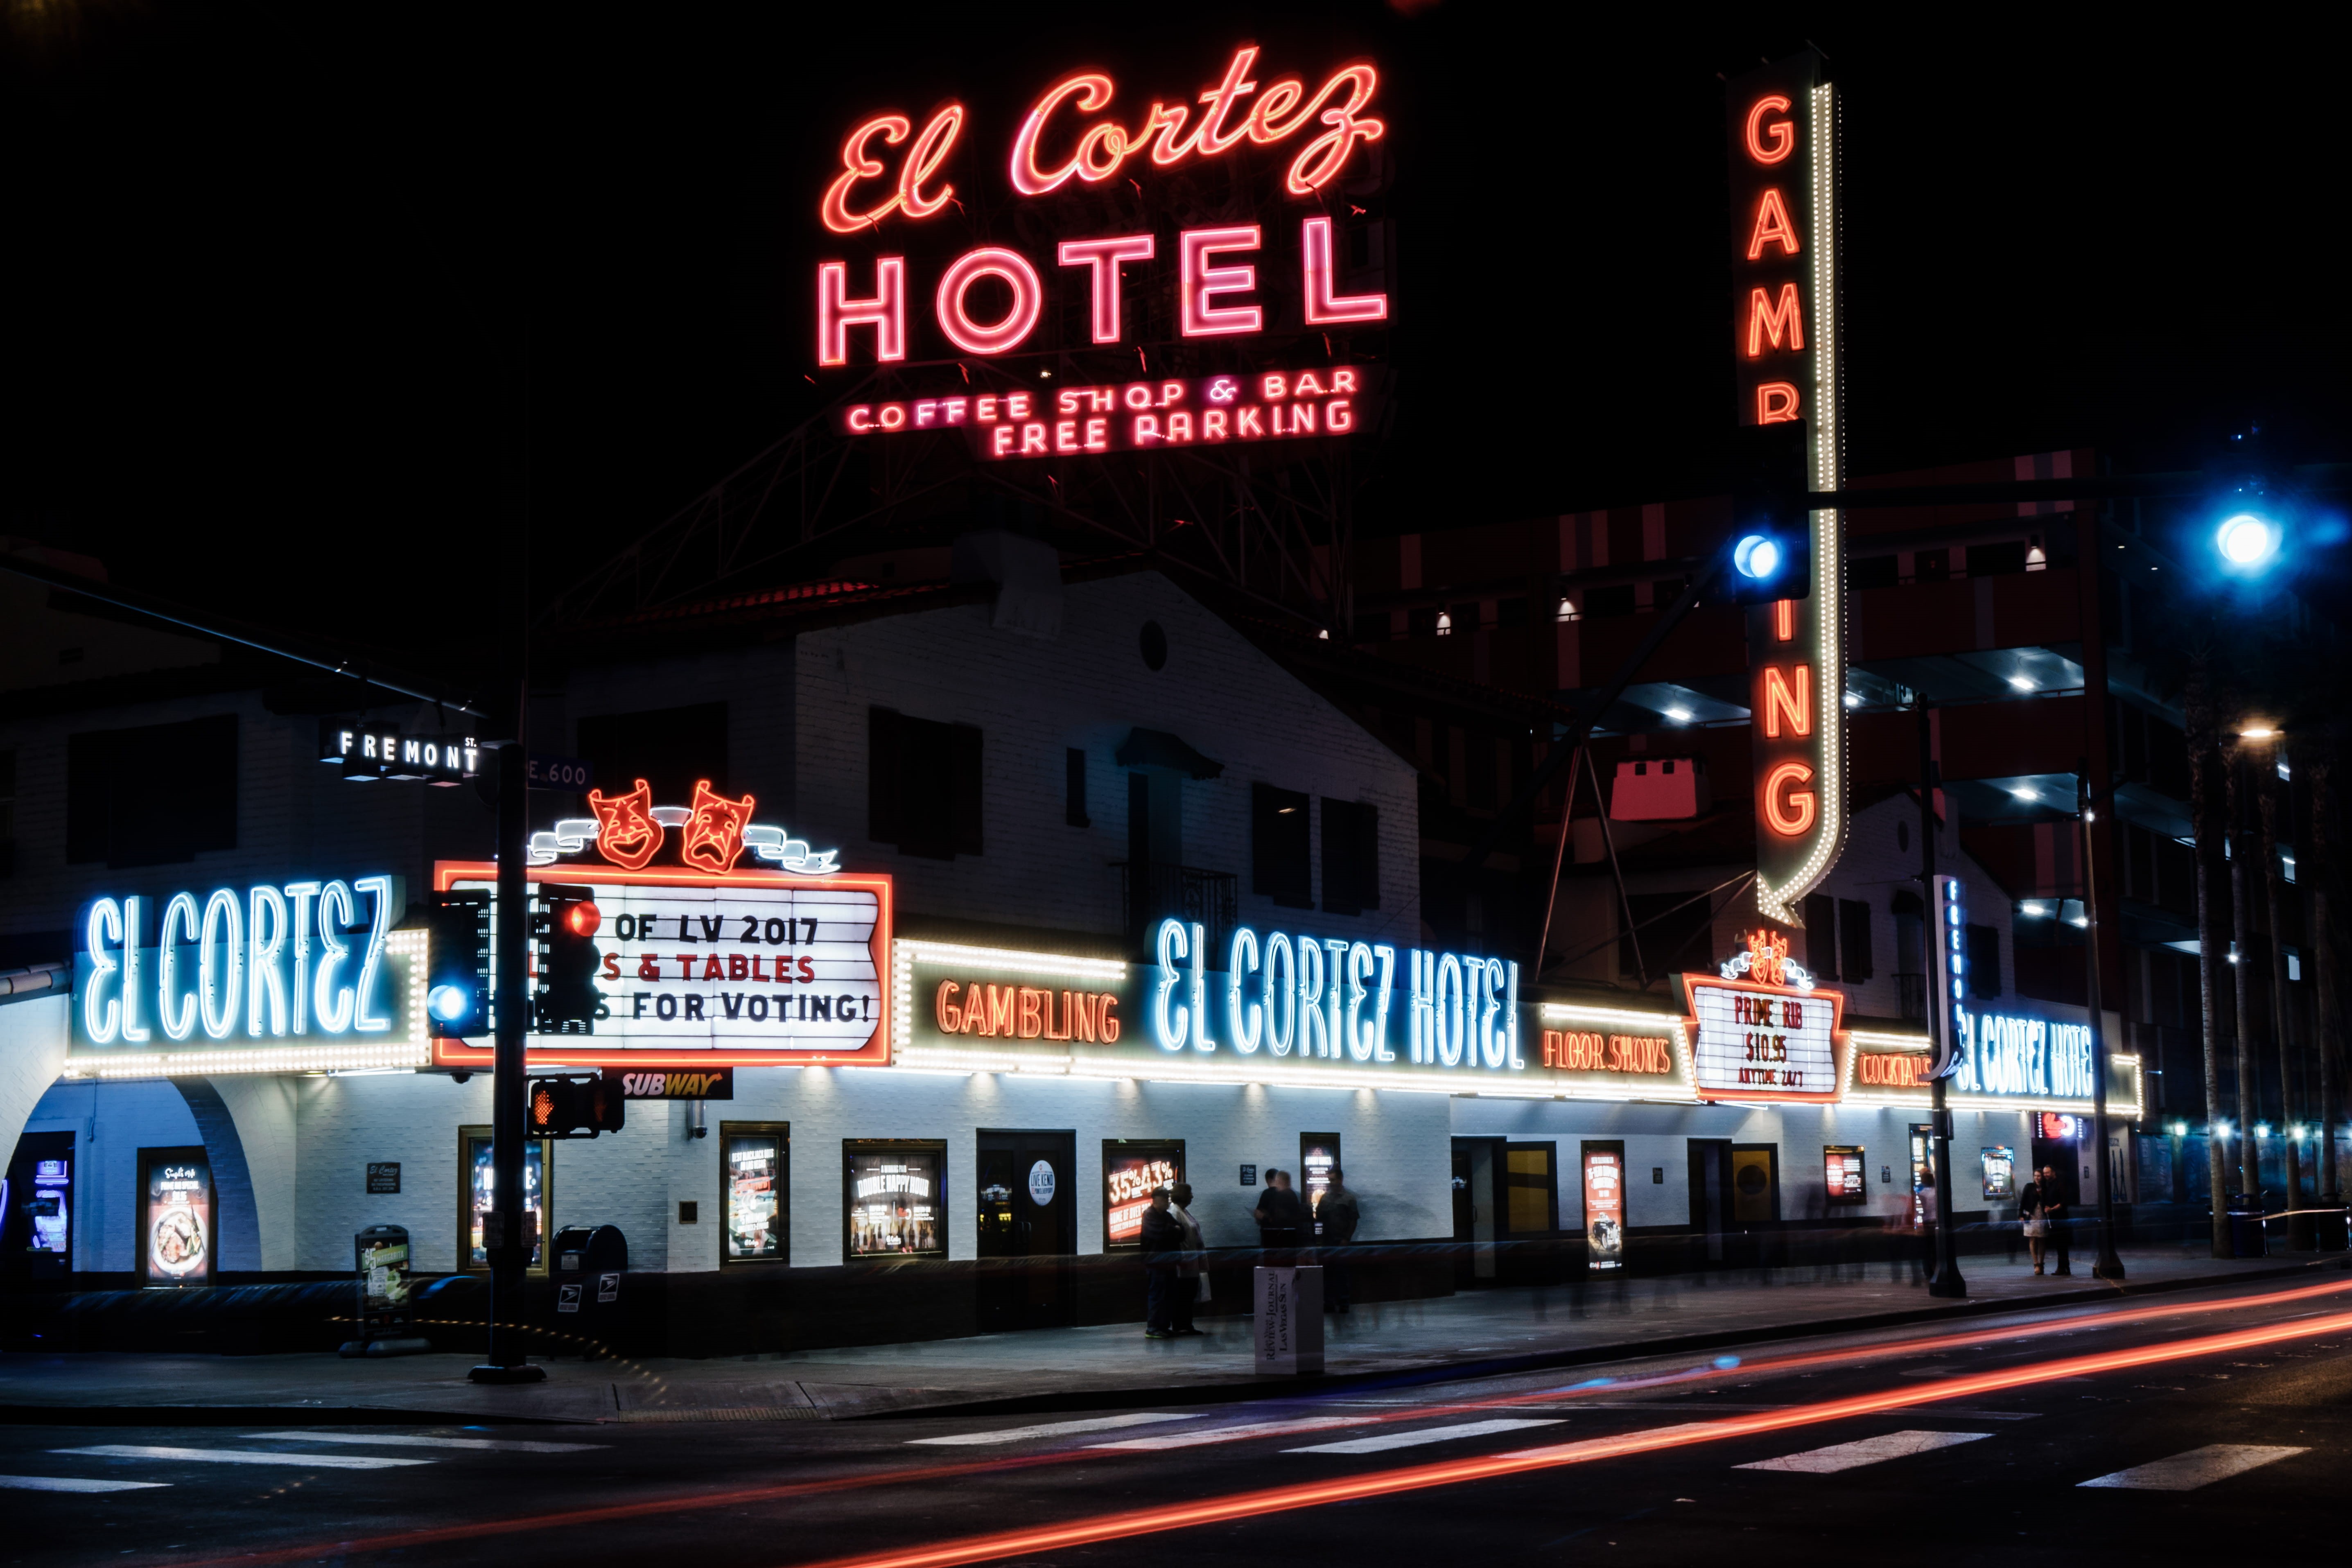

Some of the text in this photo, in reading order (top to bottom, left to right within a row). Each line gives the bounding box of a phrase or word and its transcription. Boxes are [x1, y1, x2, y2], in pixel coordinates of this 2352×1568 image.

[821, 46, 1385, 233] El Cortez
[819, 217, 1387, 366] HOTEL
[848, 370, 1357, 432] COFFEE SHOP & BAR
[994, 400, 1351, 457] FREE PARKING
[1746, 94, 1816, 836] GAMBING
[341, 731, 478, 772] FREMONT ST.
[549, 763, 586, 786] 600
[615, 913, 818, 945] OF LV 2017
[84, 875, 395, 1044] EL CORTEZ
[637, 953, 660, 982] &
[676, 953, 815, 984] TABLES
[633, 992, 705, 1022] FOR
[721, 993, 870, 1023] VOTING!
[1155, 917, 1525, 1070] EL CORTEZ HOTEL
[935, 978, 1120, 1045] GAMBLING
[1782, 1001, 1803, 1030] RIB
[1543, 1029, 1671, 1074] FLOOR SHOWS
[1746, 1031, 1787, 1063] $10.95
[1981, 1013, 2049, 1095] CORTEZ
[2050, 1022, 2093, 1097] HOTE
[622, 1073, 723, 1096] SUBWAY
[1782, 1070, 1803, 1087] 24/7
[857, 1174, 929, 1198] DOUBLE HAPPY HOUR
[1031, 1173, 1053, 1186] LIVE KENO
[1109, 1169, 1141, 1204] 35%
[1141, 1160, 1174, 1193] 43%
[1123, 1208, 1129, 1221] OF
[365, 1247, 377, 1270] $5
[376, 1250, 404, 1264] MARGARITA
[1267, 1271, 1277, 1360] REVIEW-JOURNAL
[1279, 1304, 1288, 1333] VEGAS
[1279, 1333, 1288, 1351] LAS
